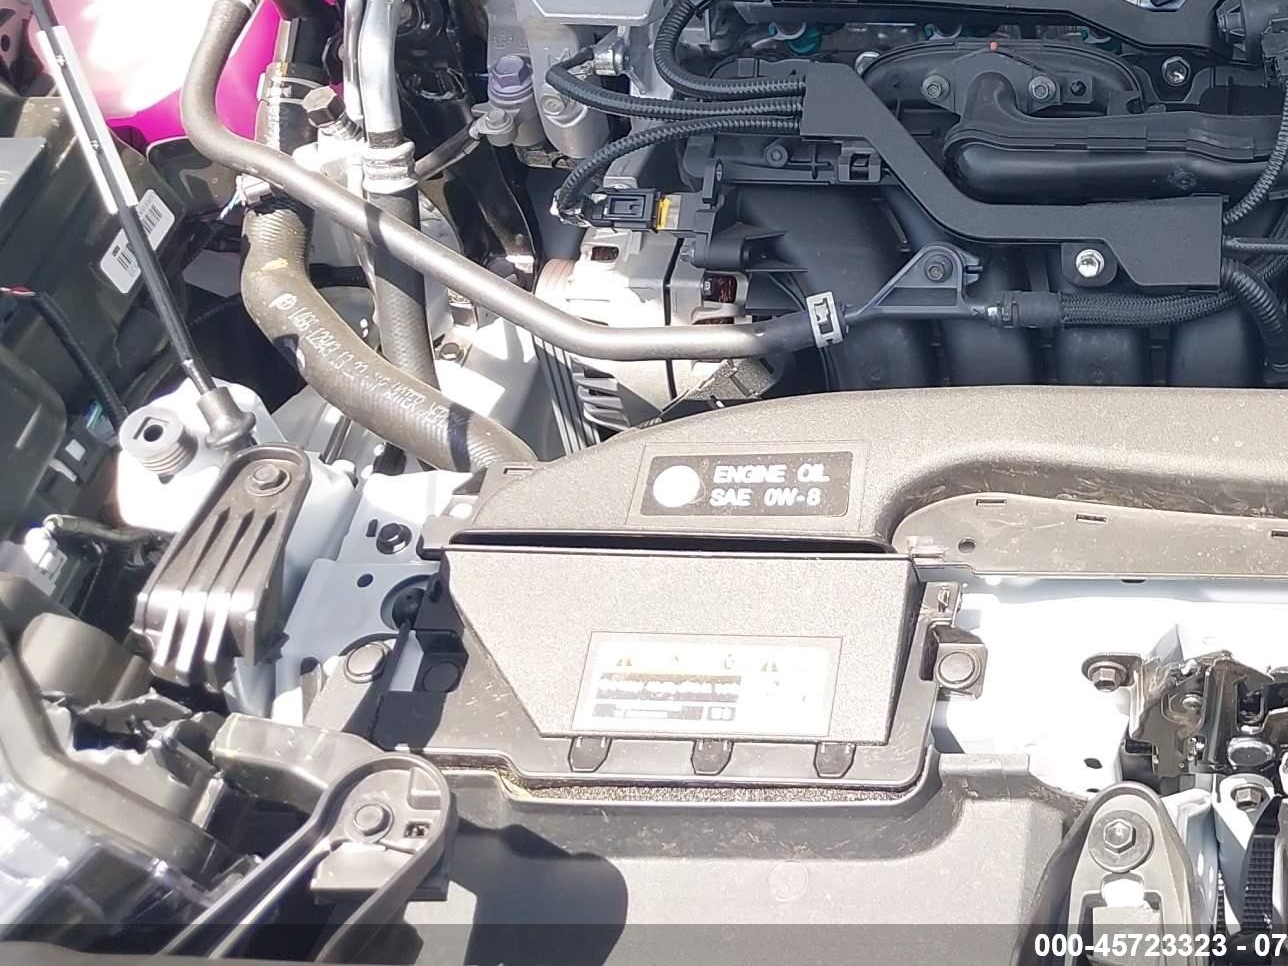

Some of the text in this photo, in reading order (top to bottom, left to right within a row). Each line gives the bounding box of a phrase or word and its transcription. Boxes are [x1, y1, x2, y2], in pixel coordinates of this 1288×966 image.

[713, 463, 830, 484] ENGINE OIL
[710, 488, 821, 507] SAE 0W-8
